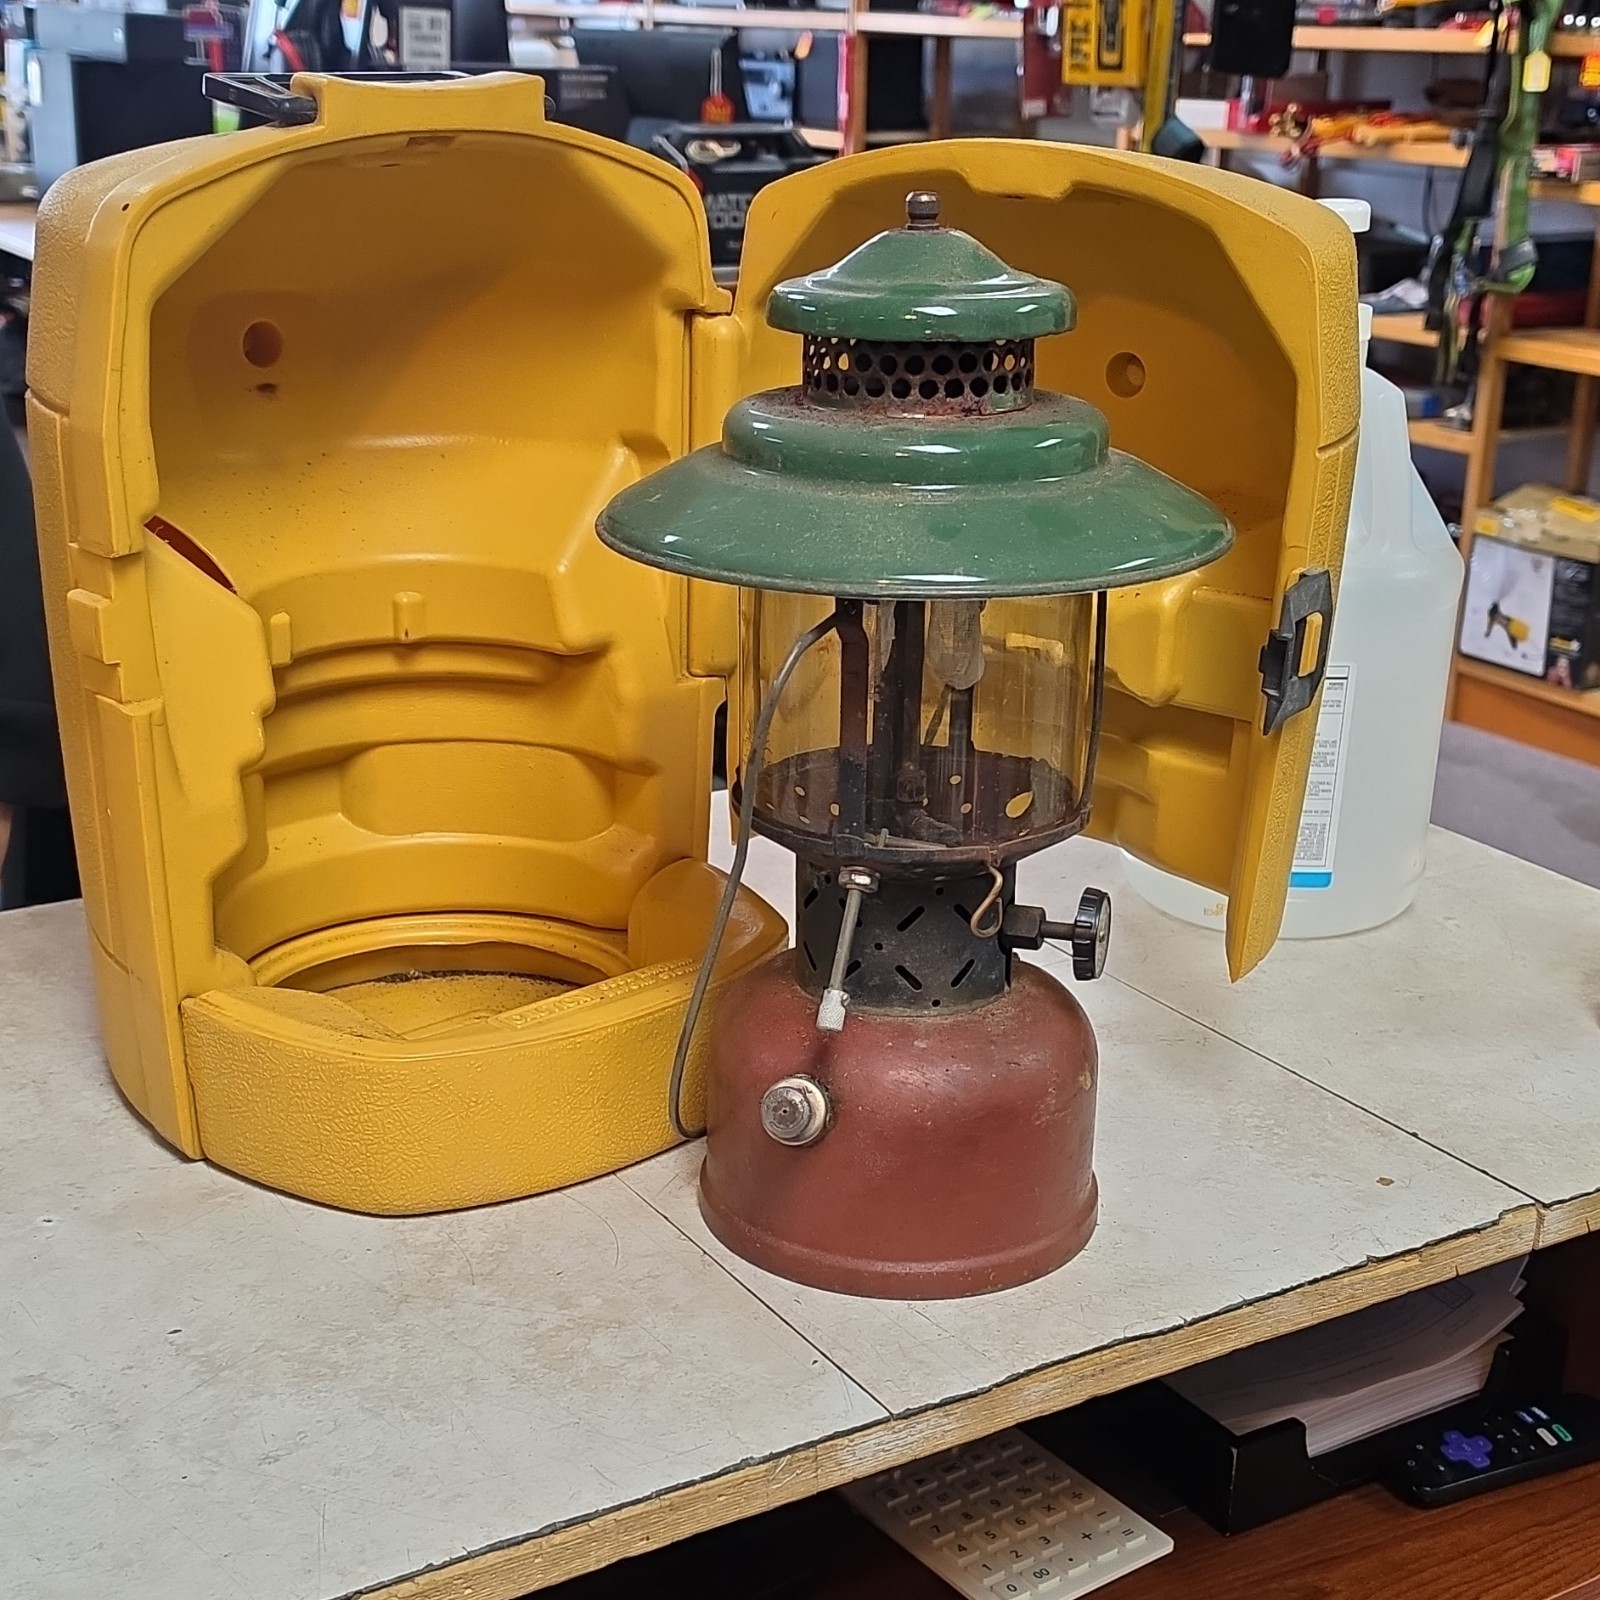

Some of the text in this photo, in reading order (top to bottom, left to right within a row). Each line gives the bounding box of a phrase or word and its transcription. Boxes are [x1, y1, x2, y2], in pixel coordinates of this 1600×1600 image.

[931, 1524, 941, 1534] 7
[961, 1511, 973, 1520] 8
[990, 1499, 1002, 1508] 9
[957, 1543, 968, 1552] 4
[984, 1530, 997, 1540] 5
[1014, 1516, 1027, 1526] 6
[981, 1563, 993, 1572] 1
[1009, 1549, 1024, 1559] 2
[1038, 1536, 1052, 1546] 3
[1006, 1583, 1018, 1593] 0
[1032, 1567, 1051, 1580] 00
